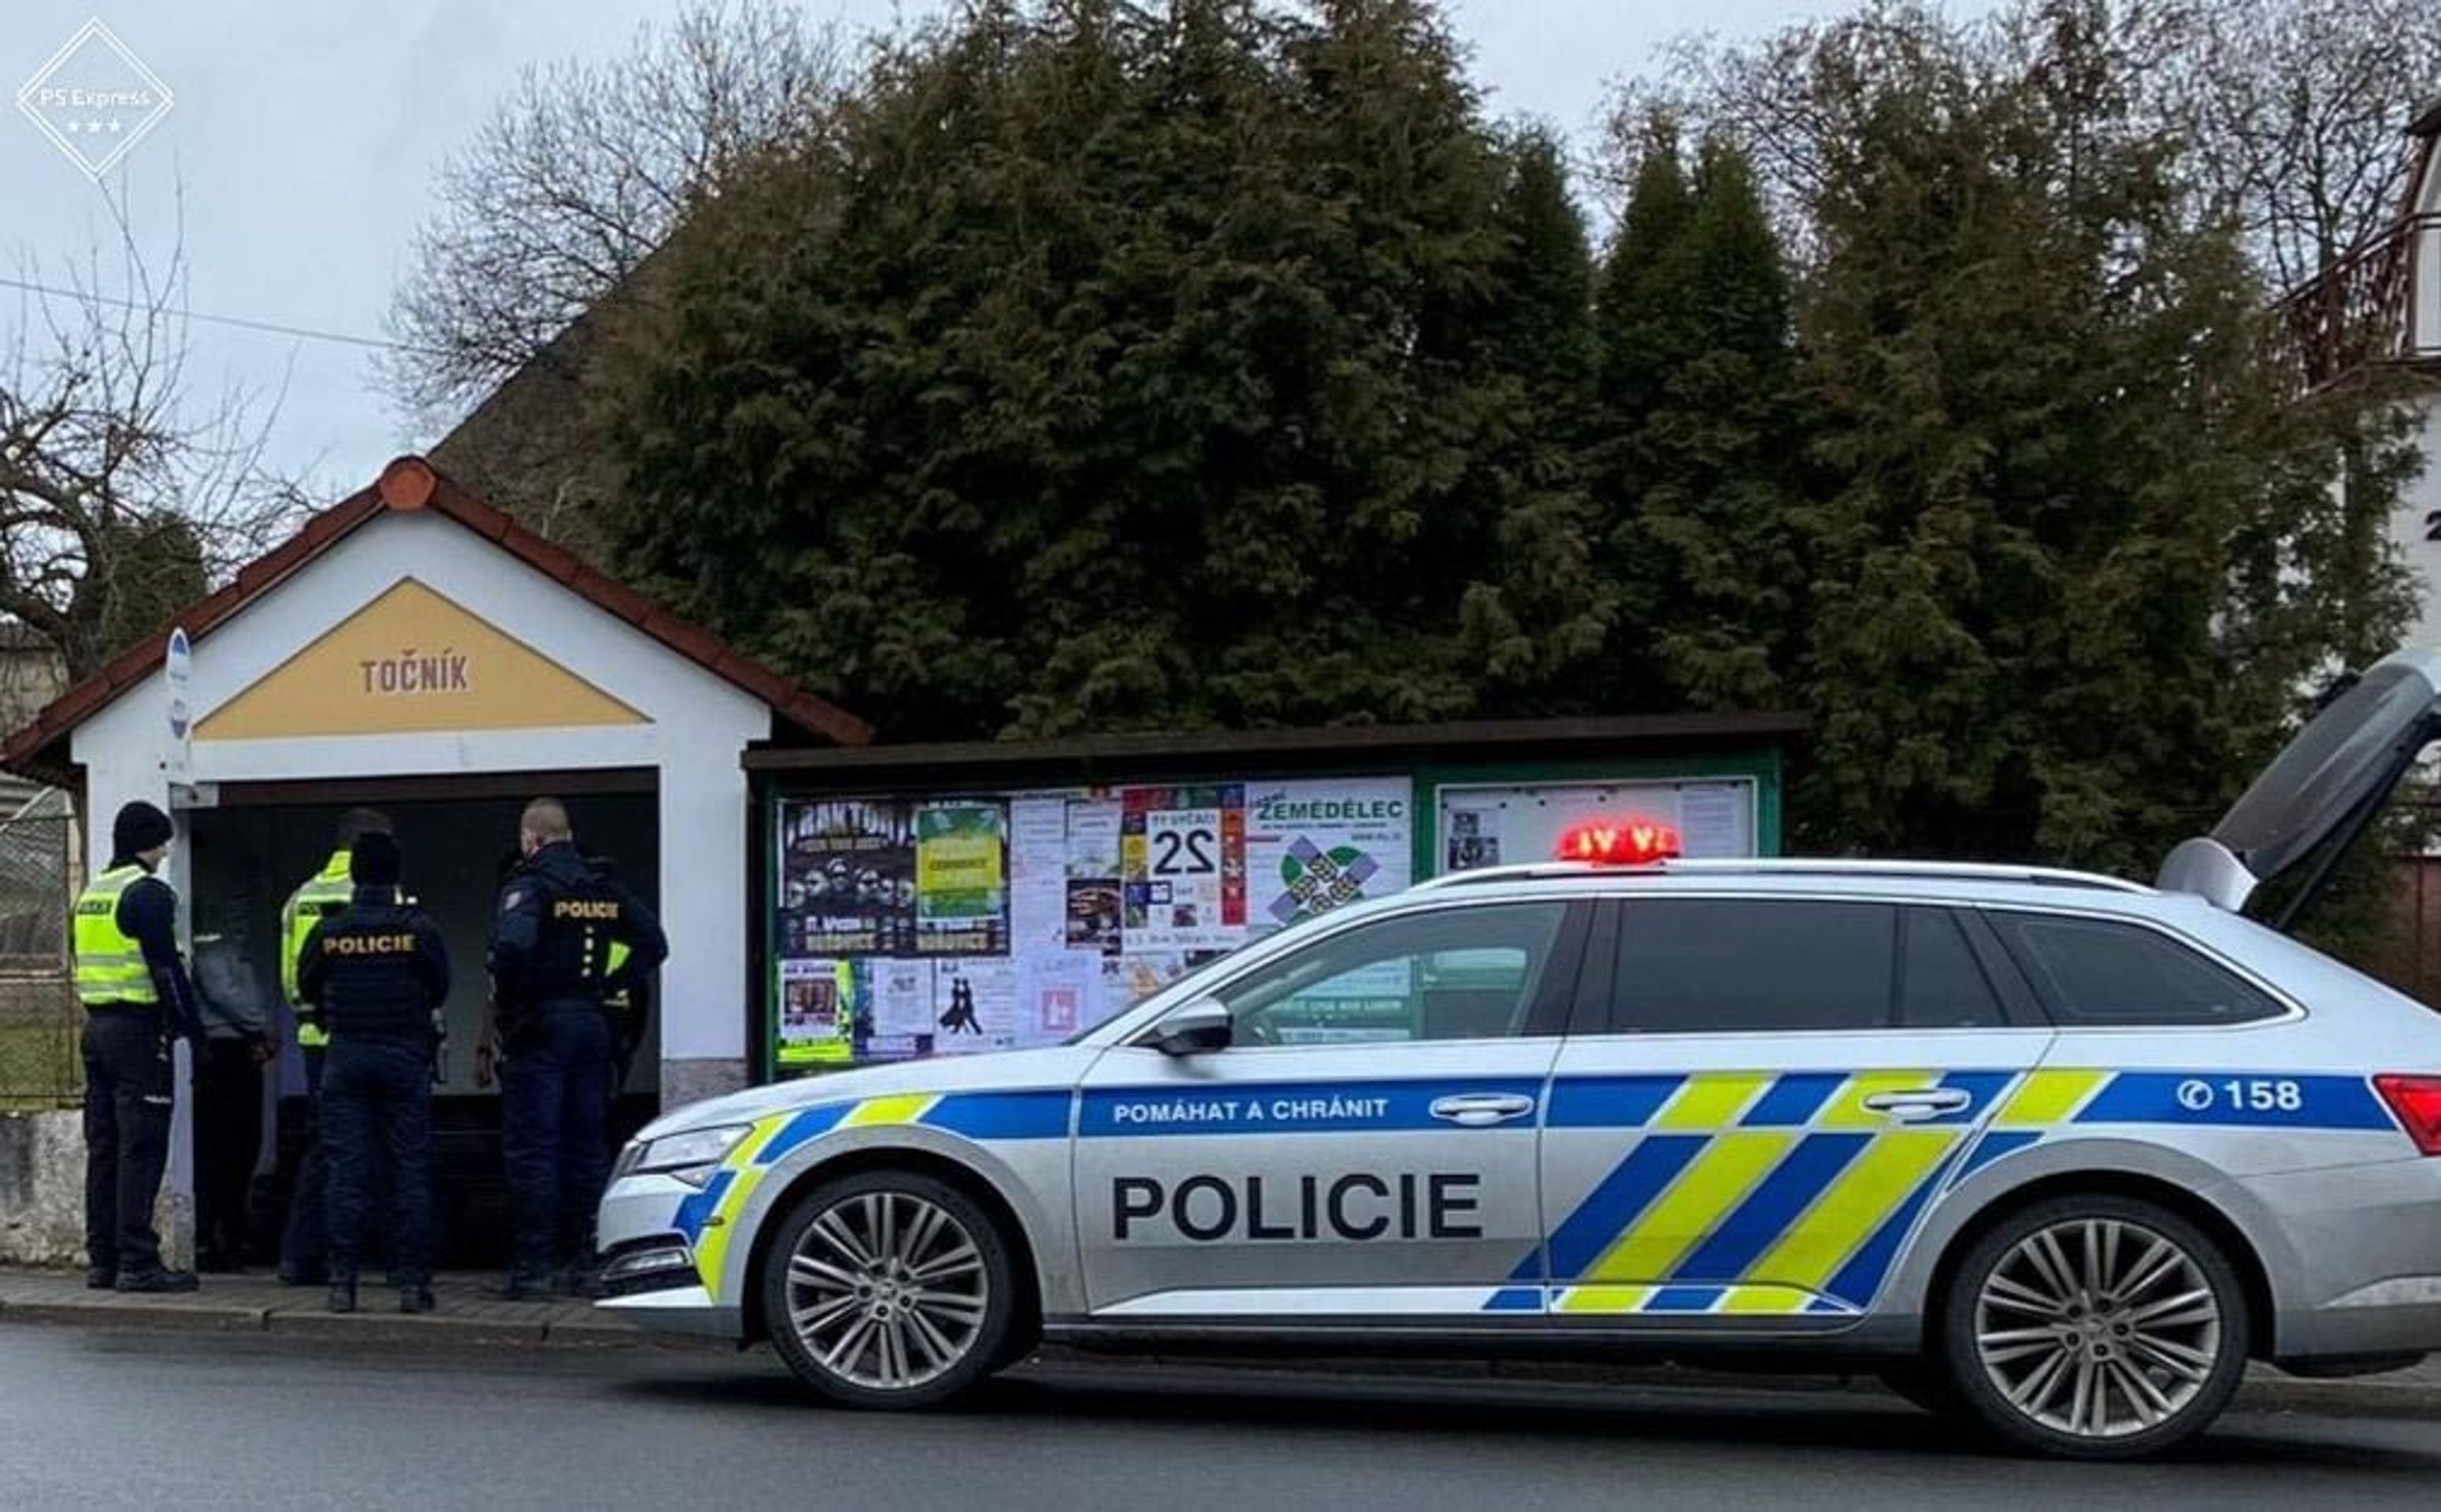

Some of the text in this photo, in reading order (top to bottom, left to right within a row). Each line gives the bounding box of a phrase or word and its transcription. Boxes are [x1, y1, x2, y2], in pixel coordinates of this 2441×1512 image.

[359, 646, 467, 693] TOČNÍK
[555, 900, 619, 919] POLICIE
[322, 933, 417, 954] POLICIE
[1114, 1095, 1390, 1123] POMÁHAT A CHRÁNIT
[2224, 1079, 2302, 1111] 158
[1112, 1173, 1483, 1240] POLICIE
